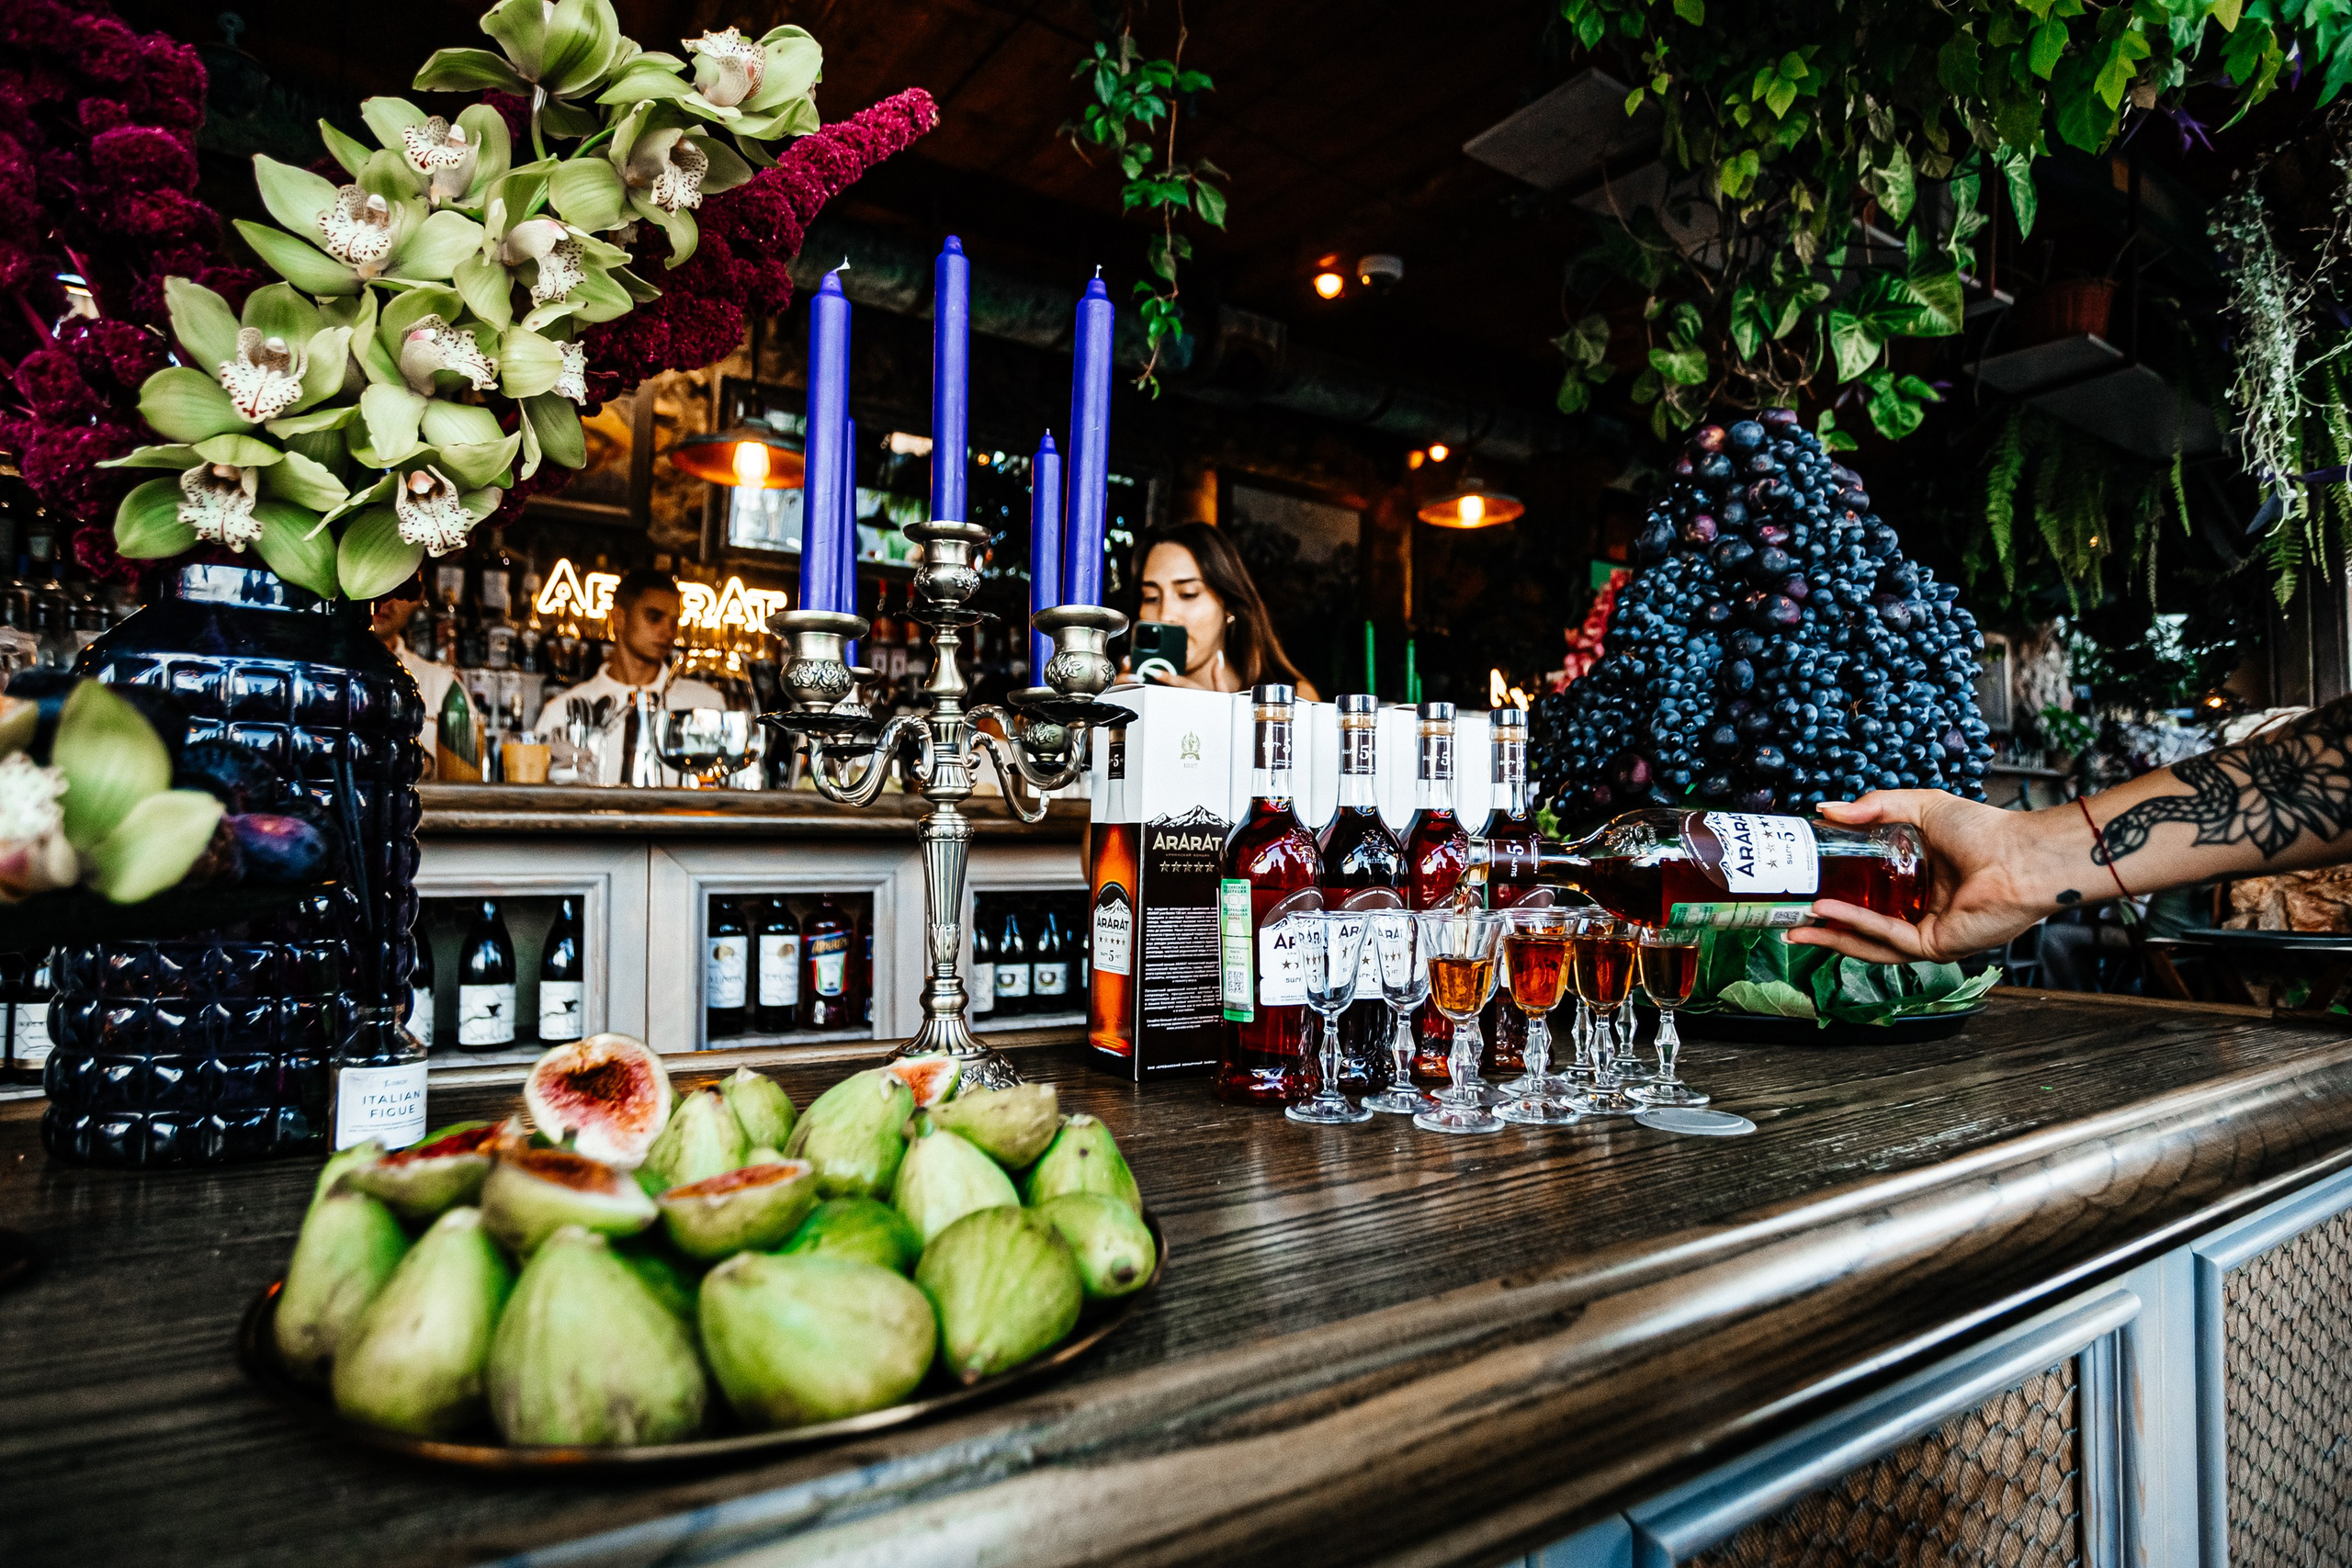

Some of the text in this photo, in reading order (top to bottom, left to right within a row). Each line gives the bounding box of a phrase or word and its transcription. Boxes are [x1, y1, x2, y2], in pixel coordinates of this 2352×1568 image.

[1283, 738, 1292, 753] 5
[1359, 744, 1370, 760] 5
[1113, 753, 1120, 768] 5
[1441, 750, 1450, 765] 5
[1152, 830, 1223, 852] ARARAT
[1776, 830, 1796, 842] 5
[1506, 844, 1524, 856] 5
[1727, 813, 1755, 877] ARARA
[1096, 914, 1130, 931] ARARAT
[1108, 950, 1114, 962] 5
[362, 1089, 421, 1105] ITALIAN
[369, 1104, 415, 1119] FIGUE
